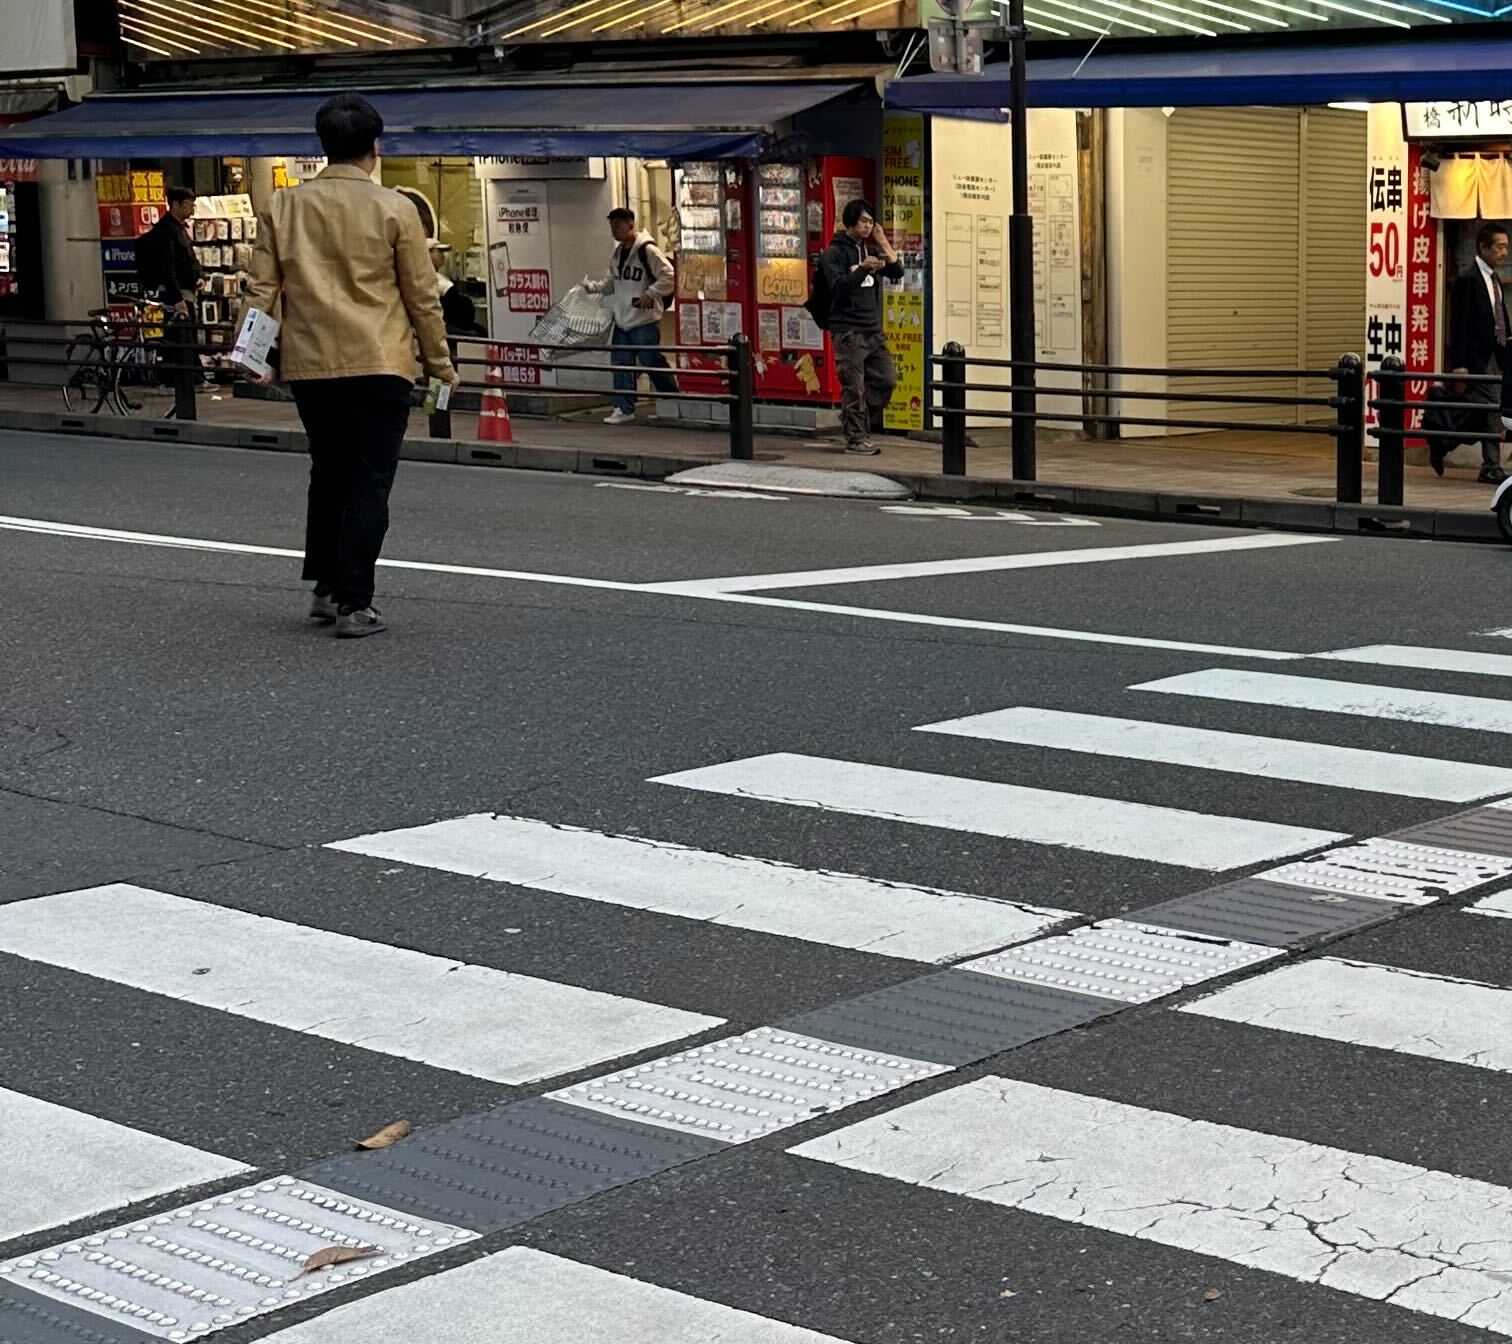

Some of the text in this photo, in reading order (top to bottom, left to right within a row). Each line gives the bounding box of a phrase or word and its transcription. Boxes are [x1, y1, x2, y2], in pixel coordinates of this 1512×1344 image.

[884, 157, 911, 169] FREE
[884, 175, 920, 187] PHONE
[1369, 165, 1402, 213] 伝串
[884, 194, 922, 207] TABLET
[884, 210, 914, 222] SHOP
[111, 248, 136, 261] iPhone
